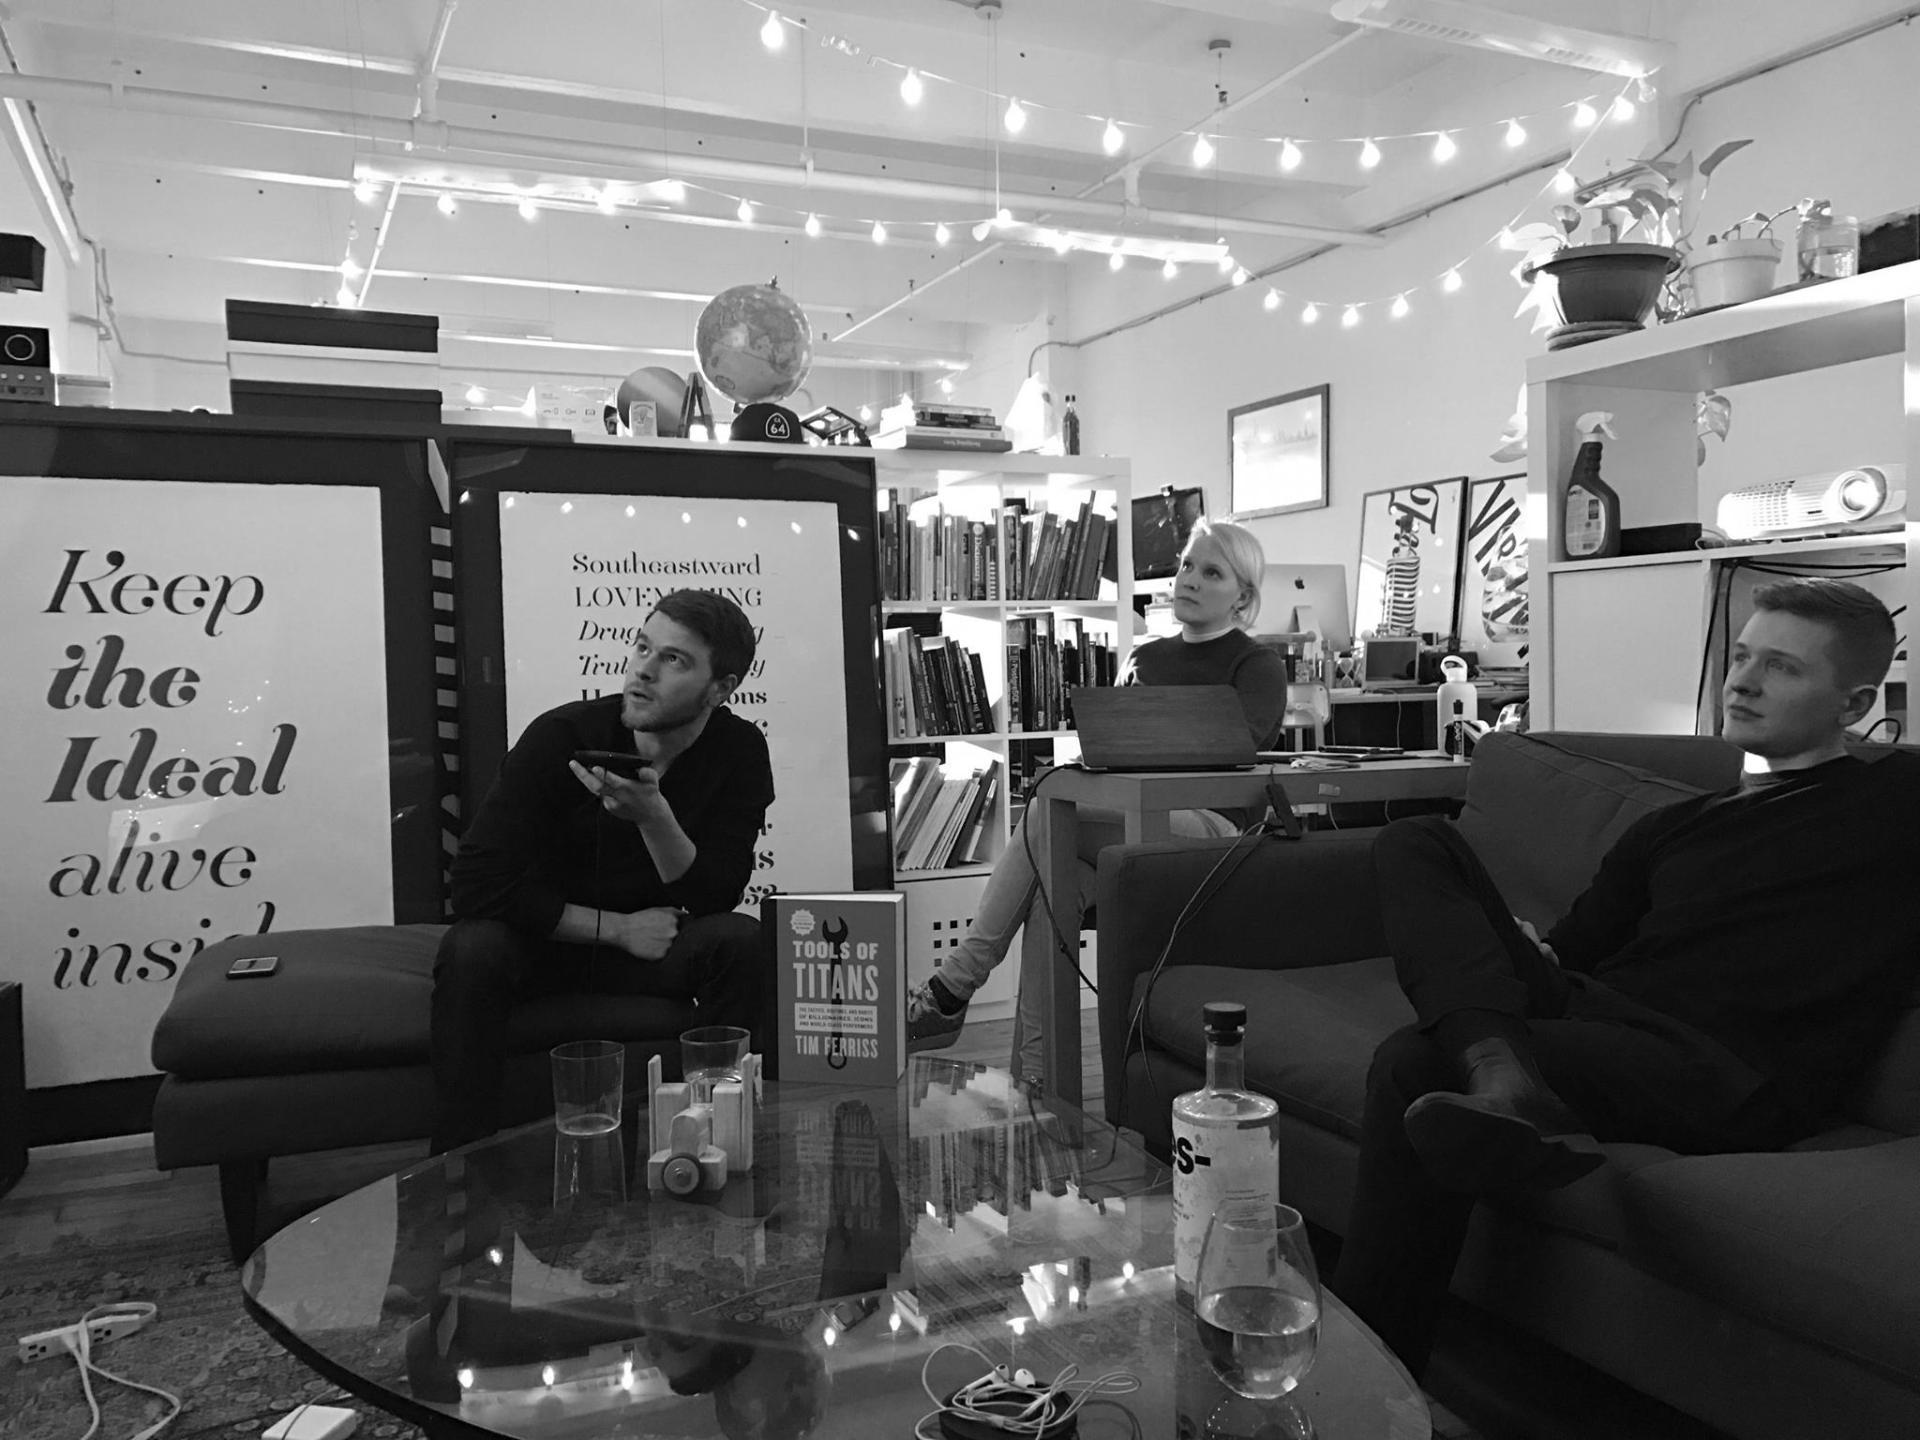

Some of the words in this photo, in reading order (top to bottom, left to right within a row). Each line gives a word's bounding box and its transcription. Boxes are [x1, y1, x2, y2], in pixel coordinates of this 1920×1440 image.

[770, 423, 786, 435] 64
[572, 550, 761, 575] Southeastward
[41, 548, 265, 637] Keep
[46, 634, 201, 711] the
[43, 723, 299, 804] Ideal
[49, 819, 257, 898] alive
[792, 940, 851, 960] TOOLS
[856, 942, 879, 961] OF
[792, 962, 879, 1002] TITANS
[795, 1034, 820, 1056] TIM
[824, 1037, 879, 1059] FERRISS
